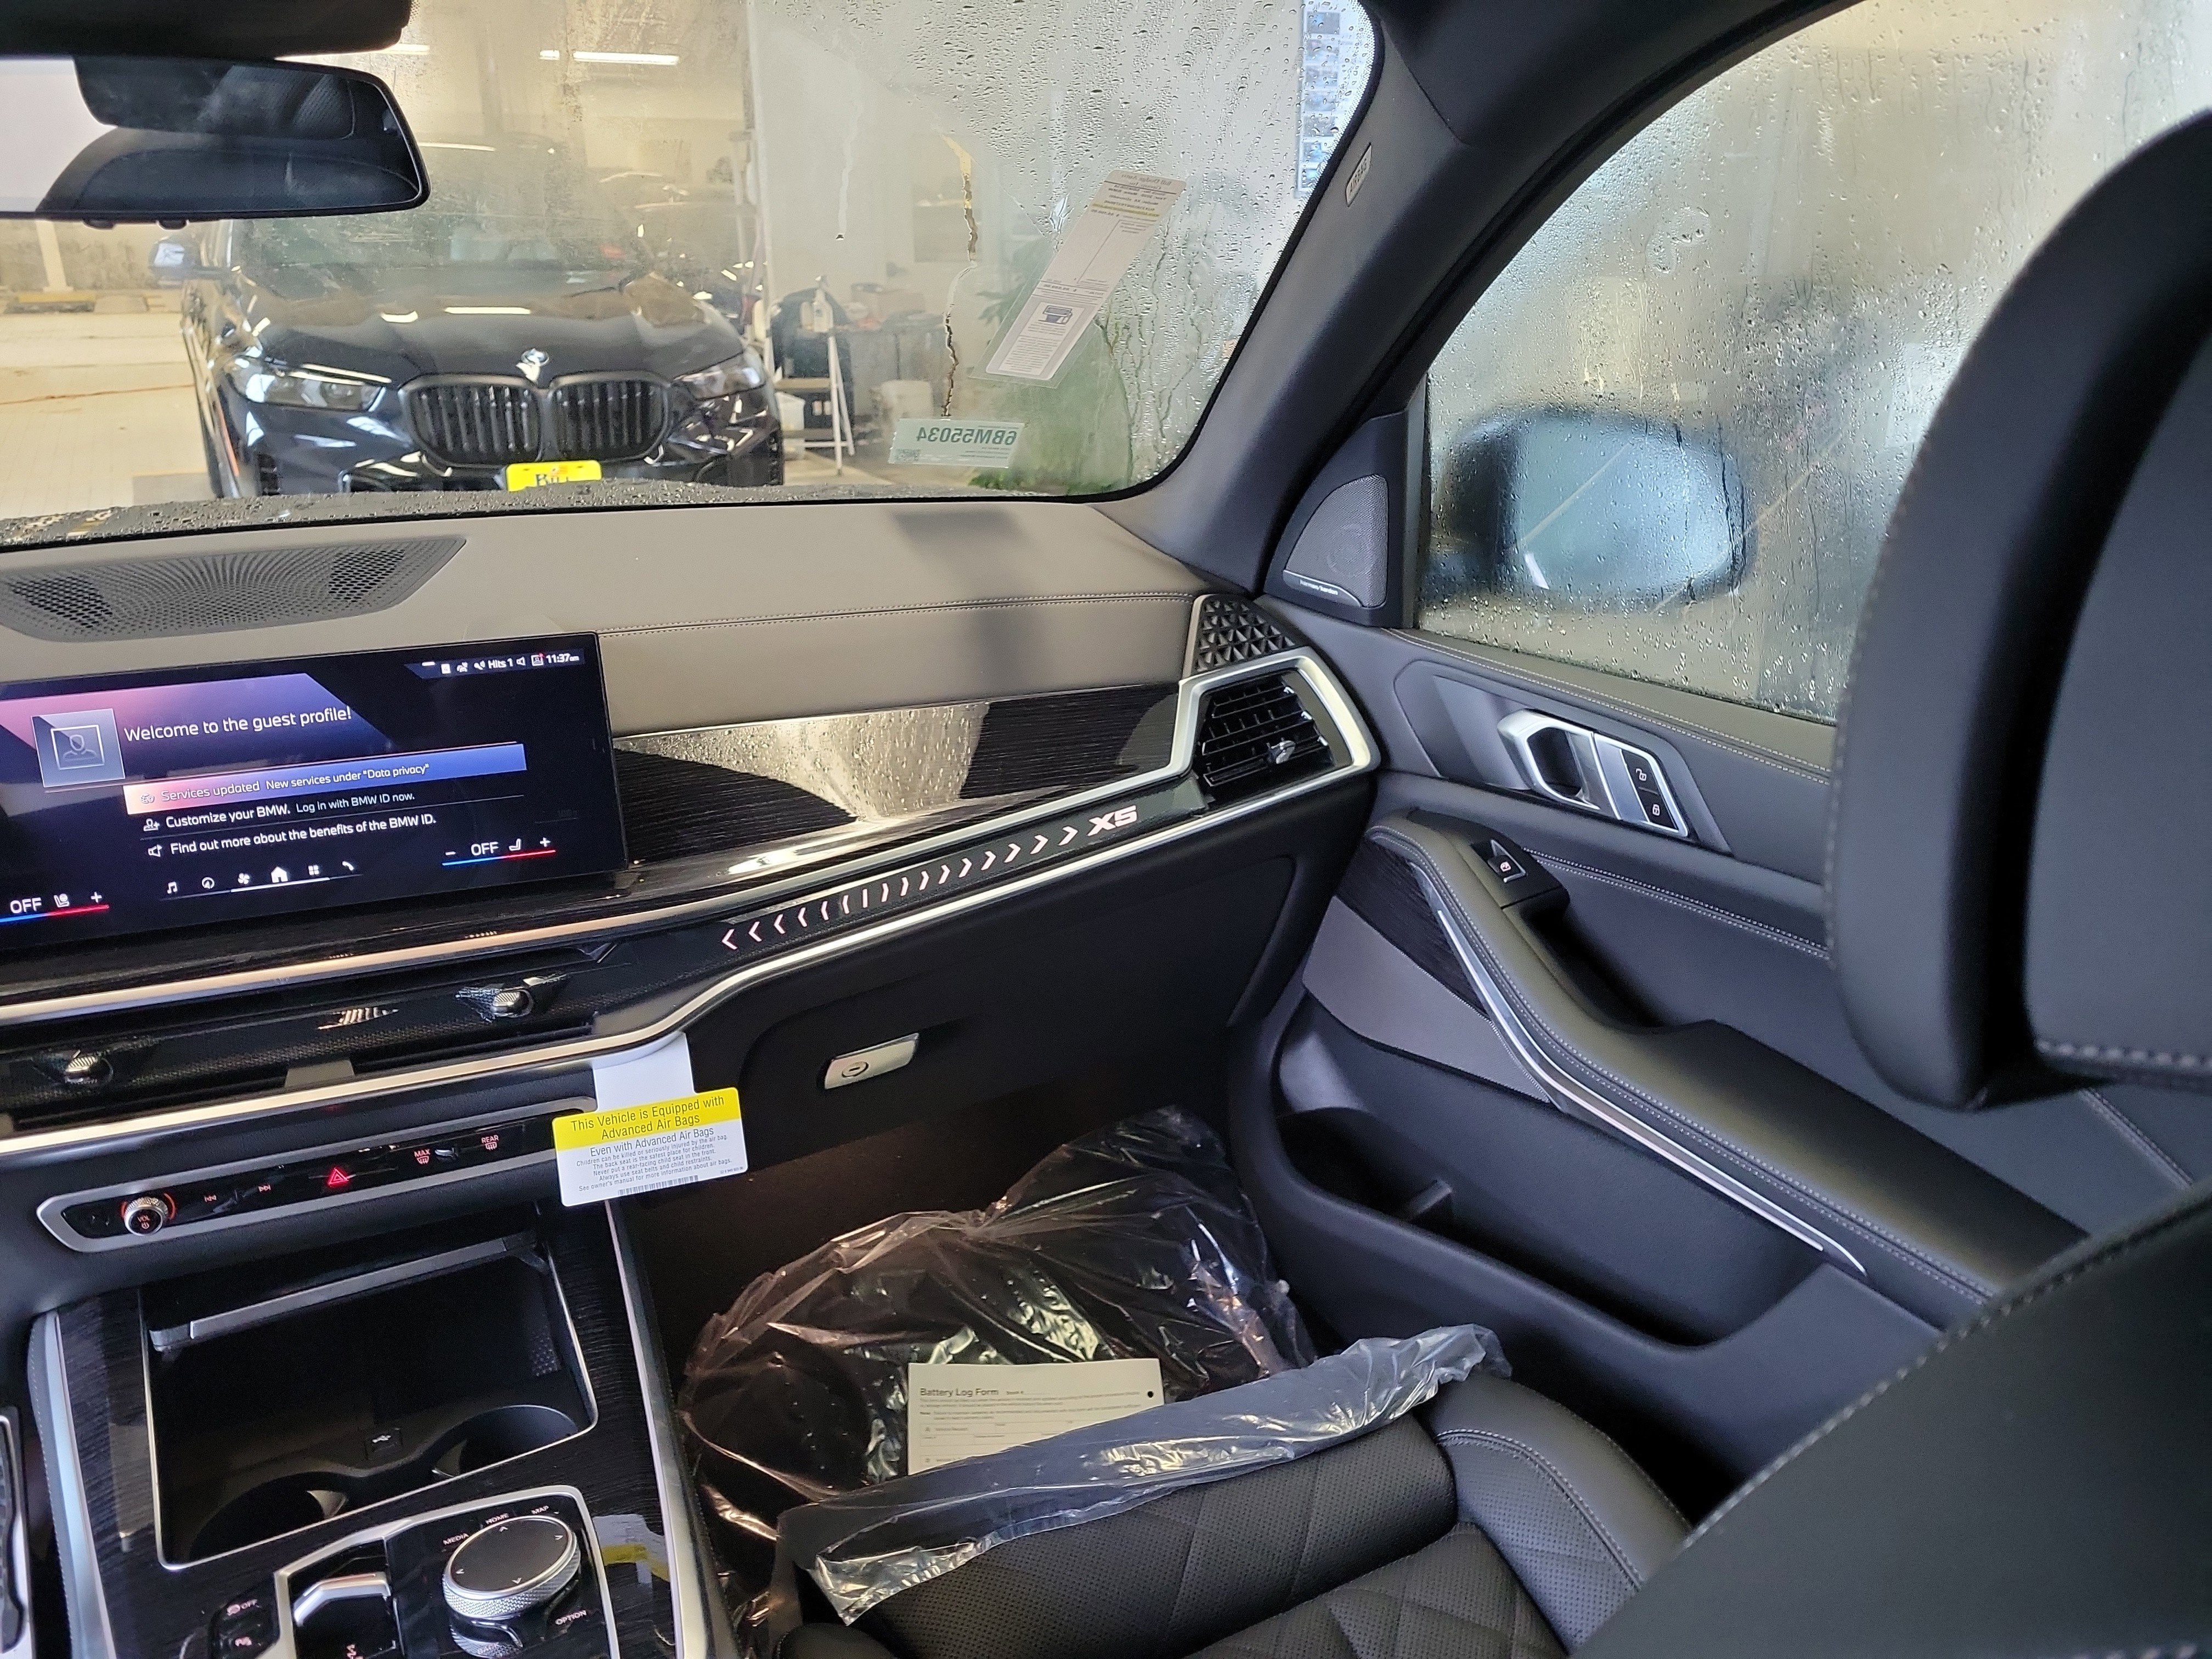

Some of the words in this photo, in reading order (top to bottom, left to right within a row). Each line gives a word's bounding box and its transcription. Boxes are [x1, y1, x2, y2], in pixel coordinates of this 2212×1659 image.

[488, 658, 506, 669] Hits
[508, 658, 514, 667] 1
[125, 724, 199, 742] Welcome
[204, 721, 218, 735] to
[223, 717, 249, 732] the
[253, 713, 296, 732] guest
[301, 707, 351, 727] profile!
[161, 787, 210, 802] Services
[213, 781, 260, 797] updated
[266, 778, 288, 790] New
[291, 775, 331, 787] services
[333, 771, 362, 782] under
[363, 768, 391, 779] "Data
[393, 764, 429, 777] privacy"
[166, 812, 227, 828] Customize
[229, 809, 255, 823] your
[257, 804, 291, 818] BMW.
[296, 802, 315, 815] Log
[318, 801, 326, 811] in
[329, 797, 349, 809] with
[351, 794, 374, 806] BMW
[376, 794, 390, 804] ID
[392, 792, 415, 802] now.
[1087, 805, 1137, 836] X5
[171, 842, 197, 855] Find
[200, 839, 219, 851] out
[221, 837, 251, 849] more
[254, 832, 287, 846] about
[289, 830, 307, 841] the
[309, 824, 353, 838] benefits
[356, 821, 367, 832] of
[369, 820, 387, 831] the
[389, 816, 418, 829] BMW
[421, 814, 436, 825] ID.
[471, 842, 499, 856] OFF
[10, 898, 42, 913] OFF
[571, 1118, 594, 1132] This
[597, 1112, 636, 1127] Vehicle
[639, 1109, 648, 1120] is
[652, 1099, 699, 1117] Equipped
[703, 1096, 724, 1109] with
[602, 1121, 653, 1140] Advanced
[657, 1117, 672, 1131] Air
[675, 1114, 700, 1128] Bags
[481, 1135, 499, 1144] REAR
[590, 1147, 611, 1156] Even
[614, 1141, 633, 1152] with
[635, 1133, 676, 1149] Advanced
[680, 1131, 691, 1141] Air
[693, 1128, 714, 1138] Bags
[414, 1149, 431, 1158] MAX
[577, 1158, 600, 1166] Children
[645, 1145, 669, 1154] seriously
[672, 1141, 690, 1149] injured
[627, 1160, 656, 1170] rear-facing
[591, 1181, 612, 1189] owner's
[662, 1166, 692, 1175] information
[920, 1389, 953, 1397] Battery
[956, 1389, 973, 1397] Log
[532, 1505, 549, 1514] MAP
[486, 1513, 510, 1525] HOME
[443, 1533, 469, 1545] MEDIA
[555, 1610, 587, 1625] OPTION
